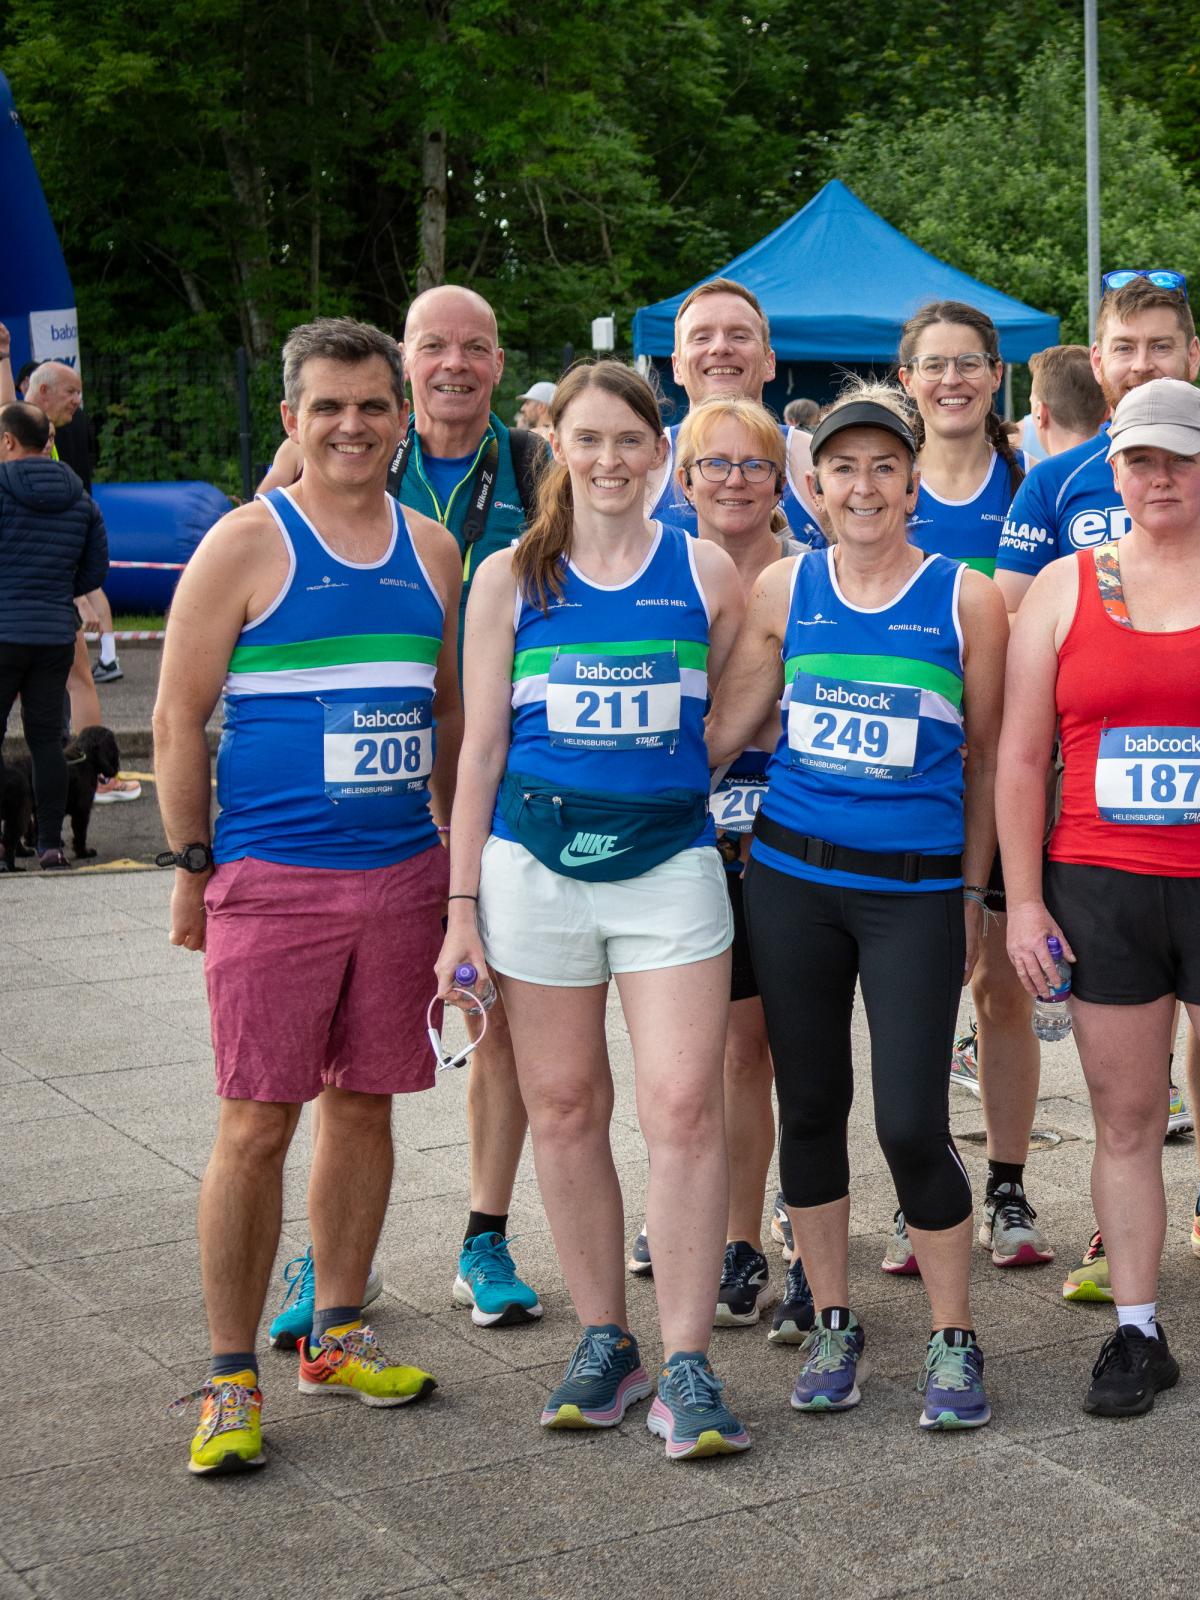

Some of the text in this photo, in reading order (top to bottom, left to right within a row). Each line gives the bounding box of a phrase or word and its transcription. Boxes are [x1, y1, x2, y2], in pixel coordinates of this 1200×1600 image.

[391, 448, 404, 474] Nikon
[476, 484, 489, 510] Nikon
[636, 598, 688, 608] ACHILLES HEEL
[888, 624, 941, 635] ACHILLES HEEL
[576, 661, 654, 681] babcock
[815, 683, 891, 710] babcock
[353, 707, 421, 728] babcock
[575, 690, 649, 728] 211
[563, 737, 617, 747] HELENSBURGH
[635, 735, 661, 745] START
[811, 712, 889, 759] 249
[354, 735, 421, 776] 208
[800, 757, 847, 772] HELENSBURGH
[864, 766, 891, 776] START
[341, 785, 393, 795] HELENSBURGH
[569, 831, 619, 855] NIKE
